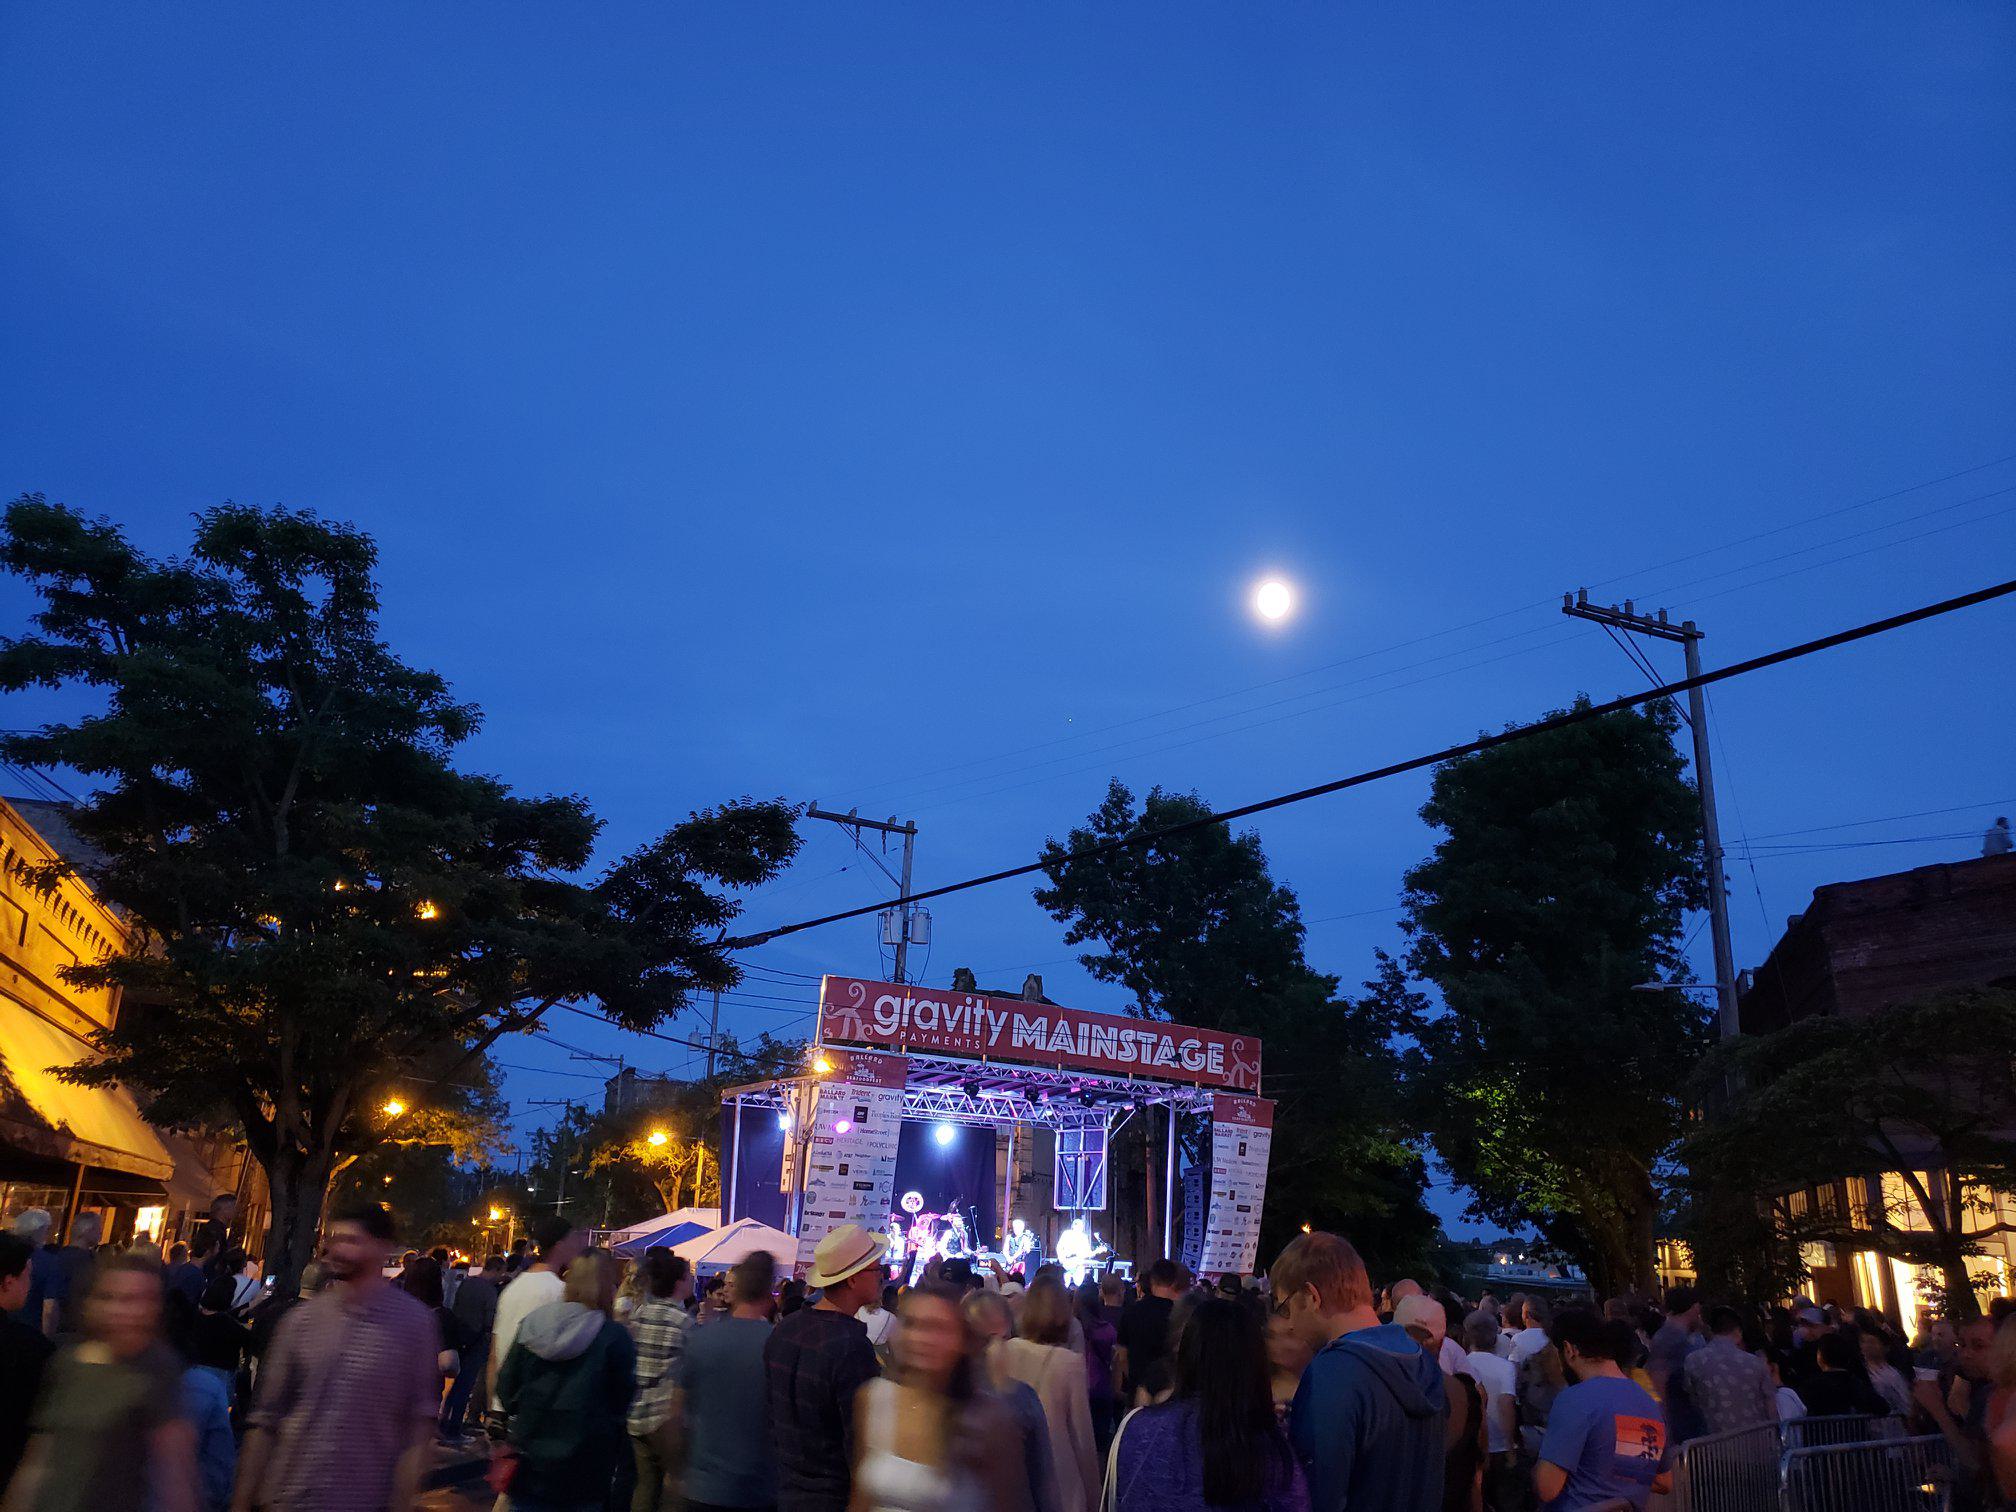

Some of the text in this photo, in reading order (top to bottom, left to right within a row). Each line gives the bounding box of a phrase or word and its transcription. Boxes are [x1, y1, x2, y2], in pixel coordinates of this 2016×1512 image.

[873, 994, 1225, 1075] gravity MAINSTAGE
[899, 1031, 980, 1049] PAYMENTS
[850, 1053, 883, 1064] BALLARD
[820, 1088, 846, 1096] BALLARD
[878, 1093, 904, 1103] gravity
